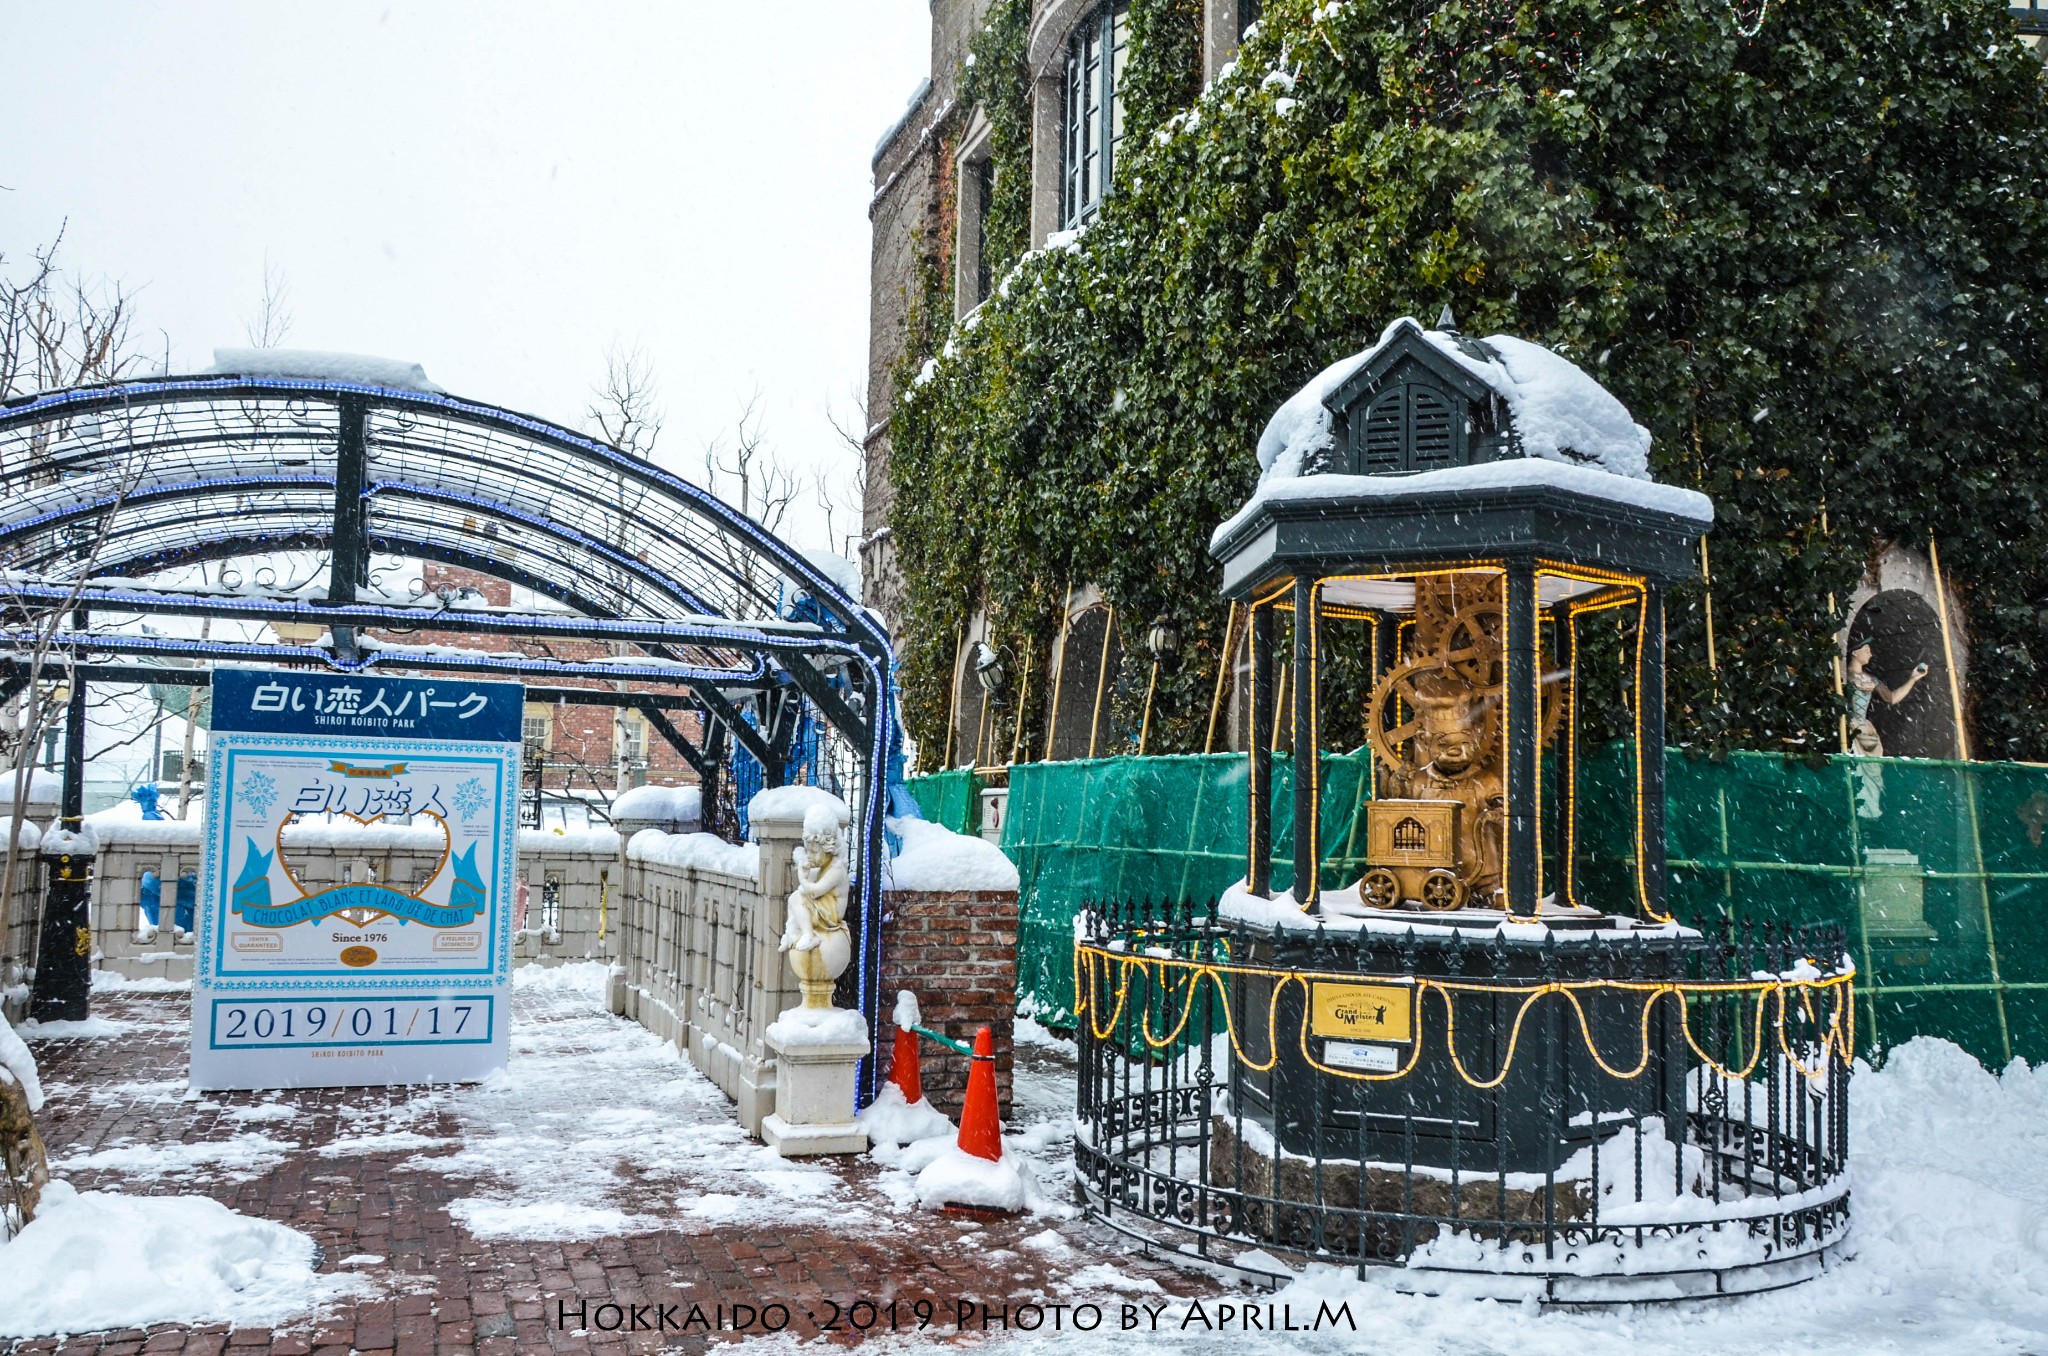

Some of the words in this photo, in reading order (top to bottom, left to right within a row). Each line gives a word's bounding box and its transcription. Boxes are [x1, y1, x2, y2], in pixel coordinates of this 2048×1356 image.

[250, 680, 489, 719] 白い恋人パーク
[314, 715, 347, 726] SHIROI
[351, 716, 388, 728] KOIBITO
[392, 718, 416, 729] PARK
[287, 777, 448, 819] 白い恋人
[253, 901, 315, 925] CHOCOLAT
[319, 890, 356, 912] BLANC
[358, 889, 372, 904] ET
[422, 906, 438, 923] DE
[440, 908, 465, 924] CHAT
[331, 932, 362, 943] Since
[364, 932, 388, 943] 1976
[1335, 1008, 1357, 1019] Grand
[1344, 1012, 1376, 1025] Meister
[225, 1006, 472, 1039] 2019/01/17
[311, 1049, 335, 1058] SHIROI
[337, 1049, 365, 1057] KOIBITO
[366, 1048, 384, 1057] PARK
